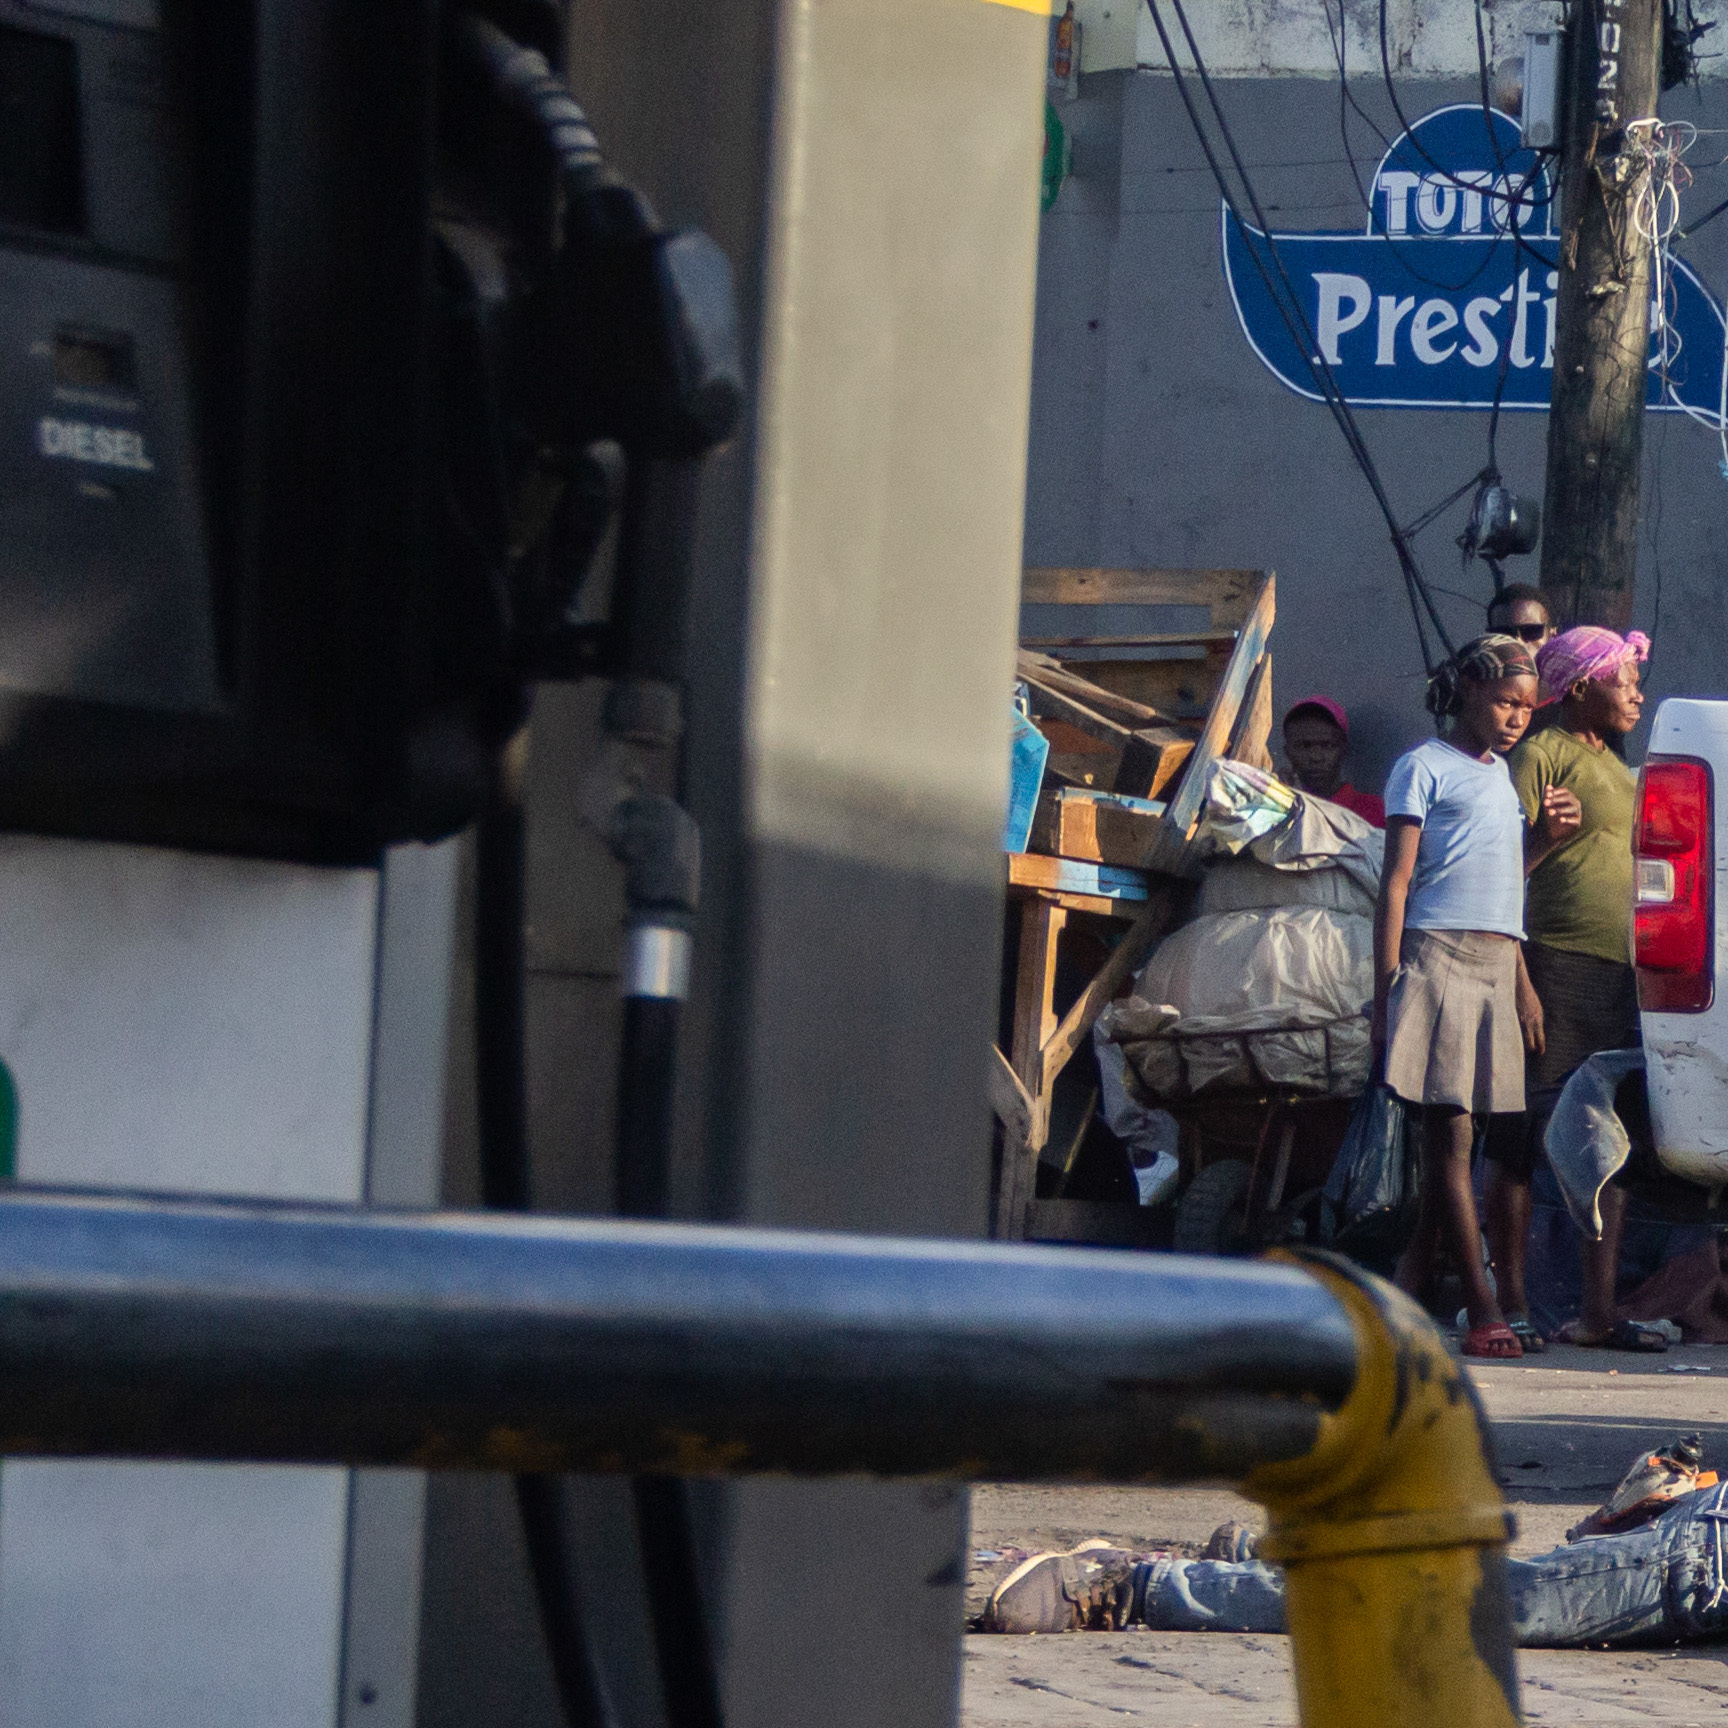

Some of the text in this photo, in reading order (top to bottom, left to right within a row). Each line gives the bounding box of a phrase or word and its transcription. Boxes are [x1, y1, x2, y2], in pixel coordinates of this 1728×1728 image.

[1377, 170, 1535, 236] TOTO
[1311, 266, 1666, 369] Presti
[40, 416, 154, 471] DIESEL
